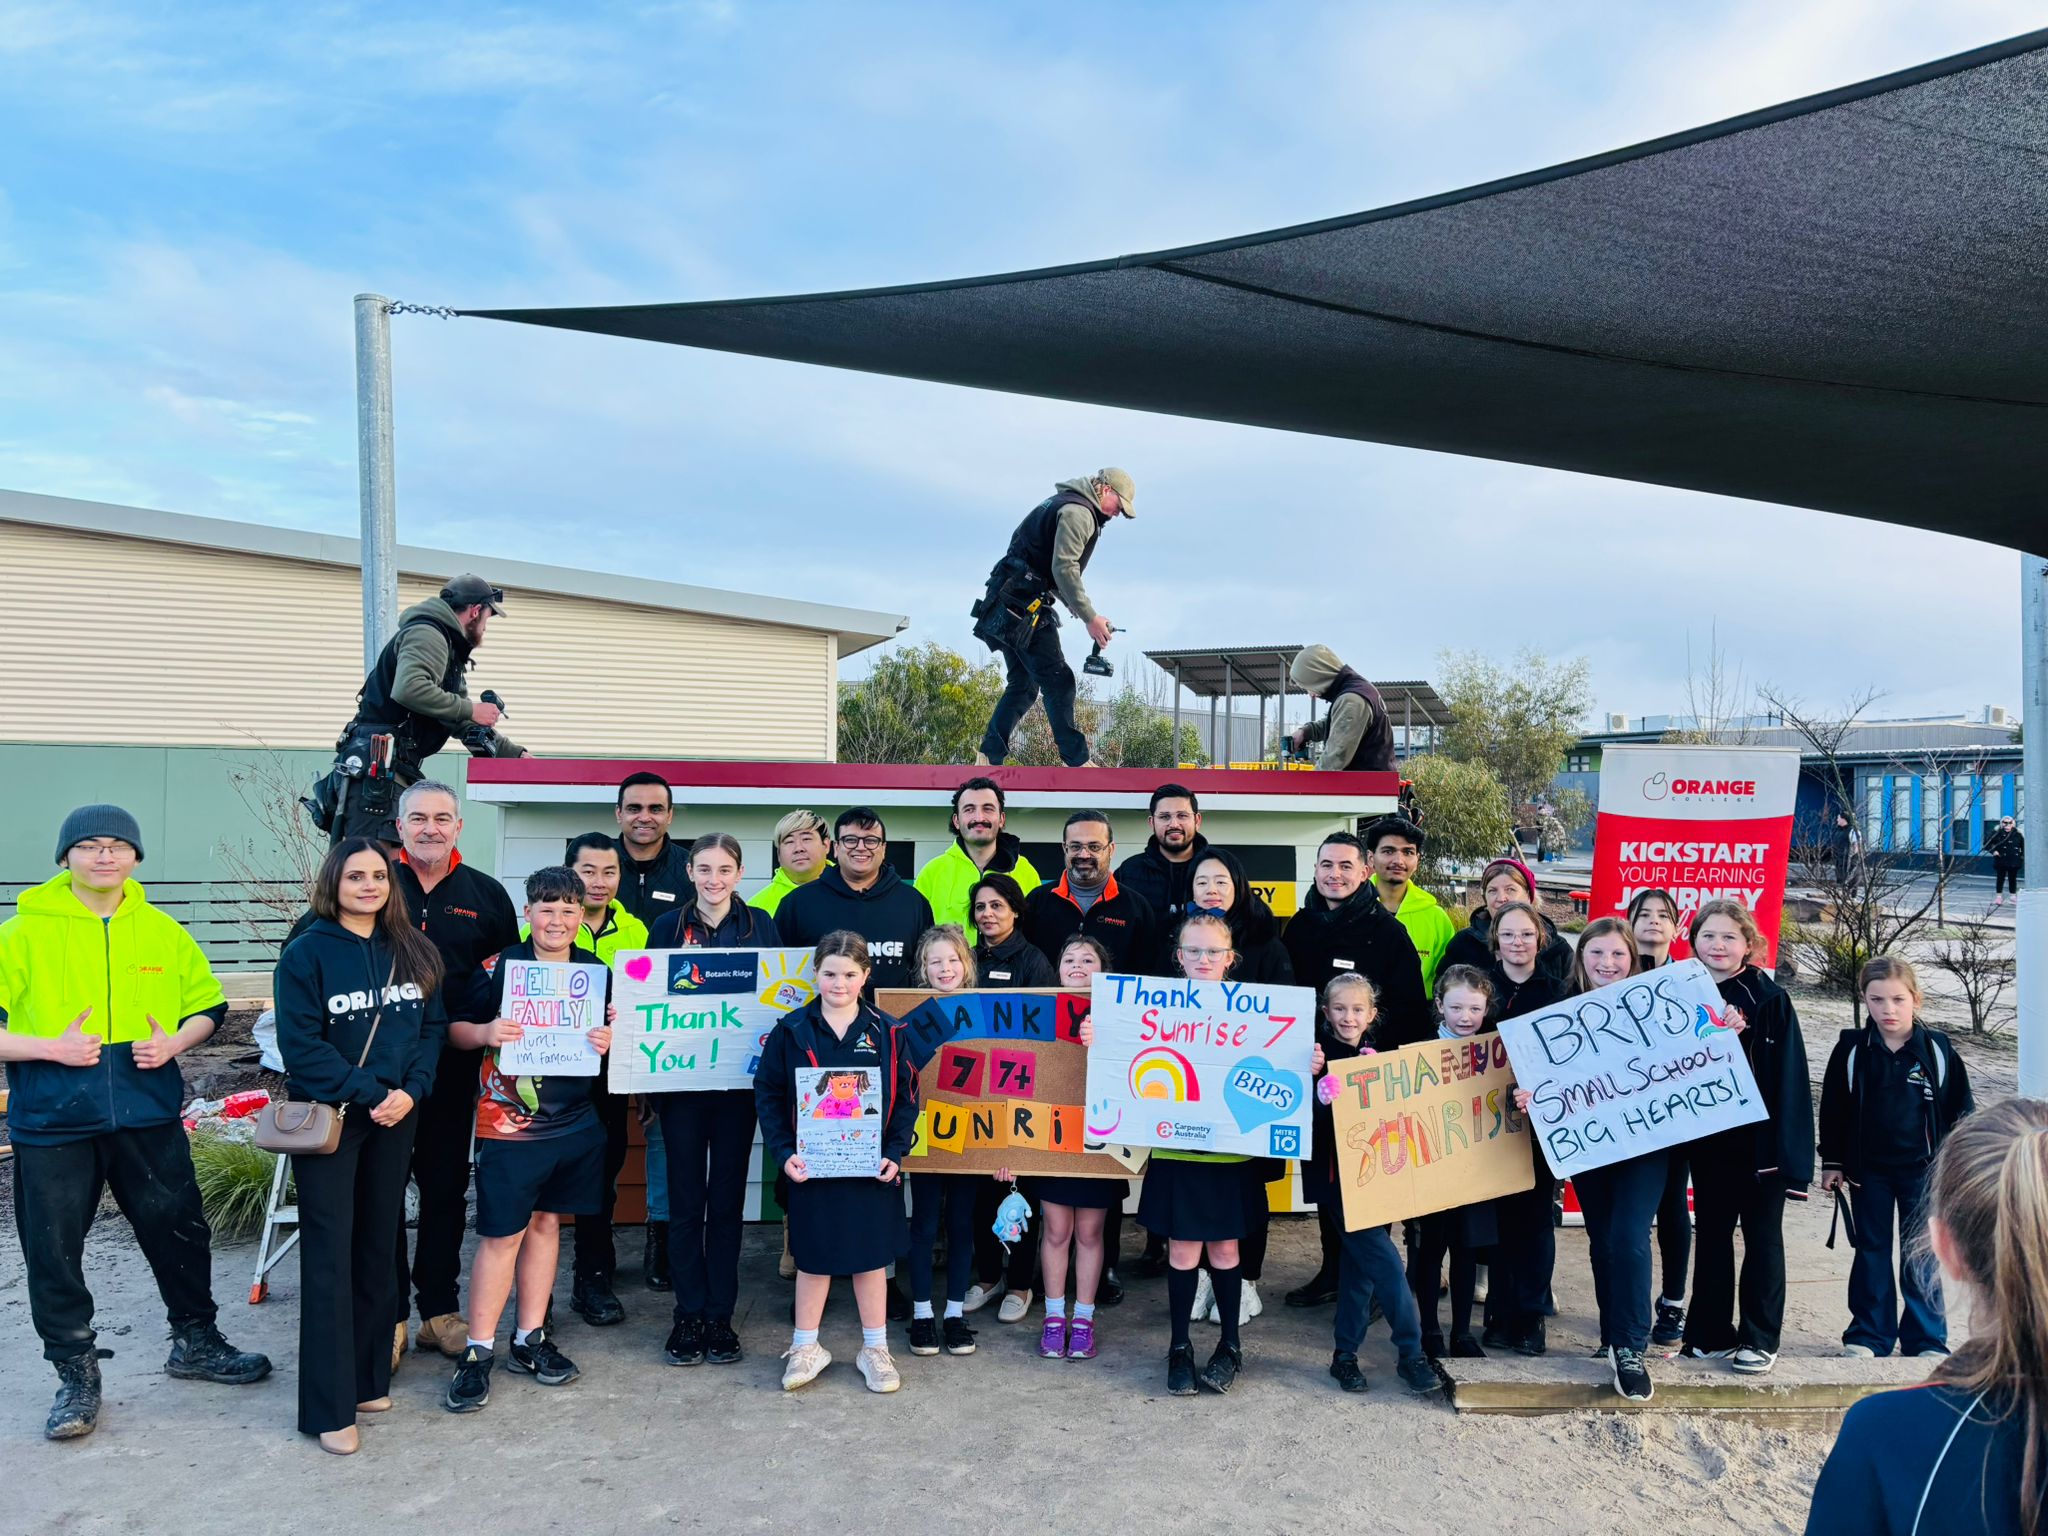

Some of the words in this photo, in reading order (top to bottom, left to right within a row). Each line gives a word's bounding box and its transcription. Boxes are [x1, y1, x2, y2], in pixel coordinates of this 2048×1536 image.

[1671, 779, 1756, 796] ORANGE
[1618, 841, 1770, 865] KICKSTART
[1617, 866, 1667, 883] YOUR
[1671, 867, 1766, 884] LEARNING
[1614, 886, 1765, 912] JRNEY
[867, 941, 904, 957] NGE
[511, 965, 590, 999] HELLO
[732, 969, 753, 979] Ridge
[1105, 975, 1202, 1009] Thank
[1220, 982, 1270, 1014] You
[636, 1001, 743, 1032] Thank
[1139, 1008, 1248, 1047] Sunrise
[1263, 1015, 1297, 1048] 7
[1531, 976, 1690, 1066] BRPS
[639, 1040, 696, 1073] You
[1234, 1070, 1293, 1109] BRPS
[1174, 1122, 1211, 1134] Carpentry
[1547, 1119, 1616, 1164] BIG
[1623, 1067, 1749, 1135] HEARTS!
[1174, 1130, 1207, 1139] Australia
[1273, 1135, 1297, 1152] 10
[1274, 1128, 1297, 1137] MITRE
[1346, 1082, 1523, 1188] SUNRISE
